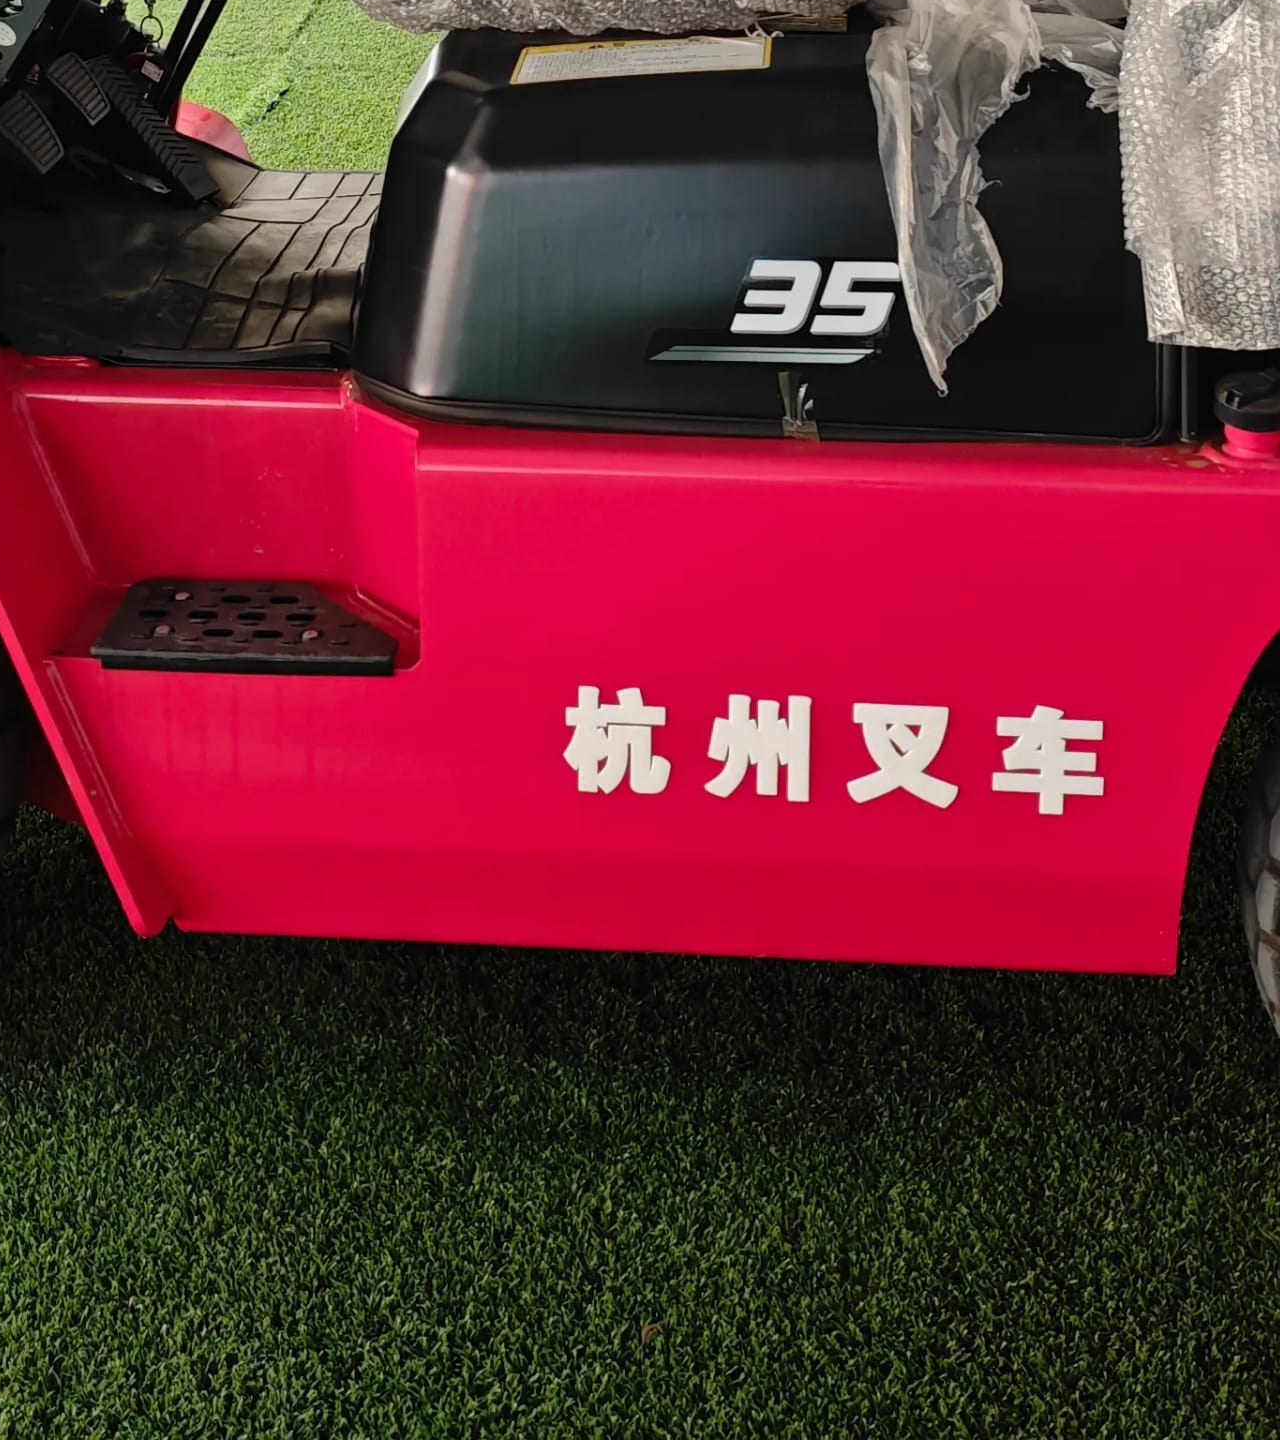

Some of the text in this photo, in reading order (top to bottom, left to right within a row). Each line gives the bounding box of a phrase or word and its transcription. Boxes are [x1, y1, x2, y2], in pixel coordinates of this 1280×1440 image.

[729, 258, 901, 335] 35
[563, 685, 1105, 816] 杭州叉车
